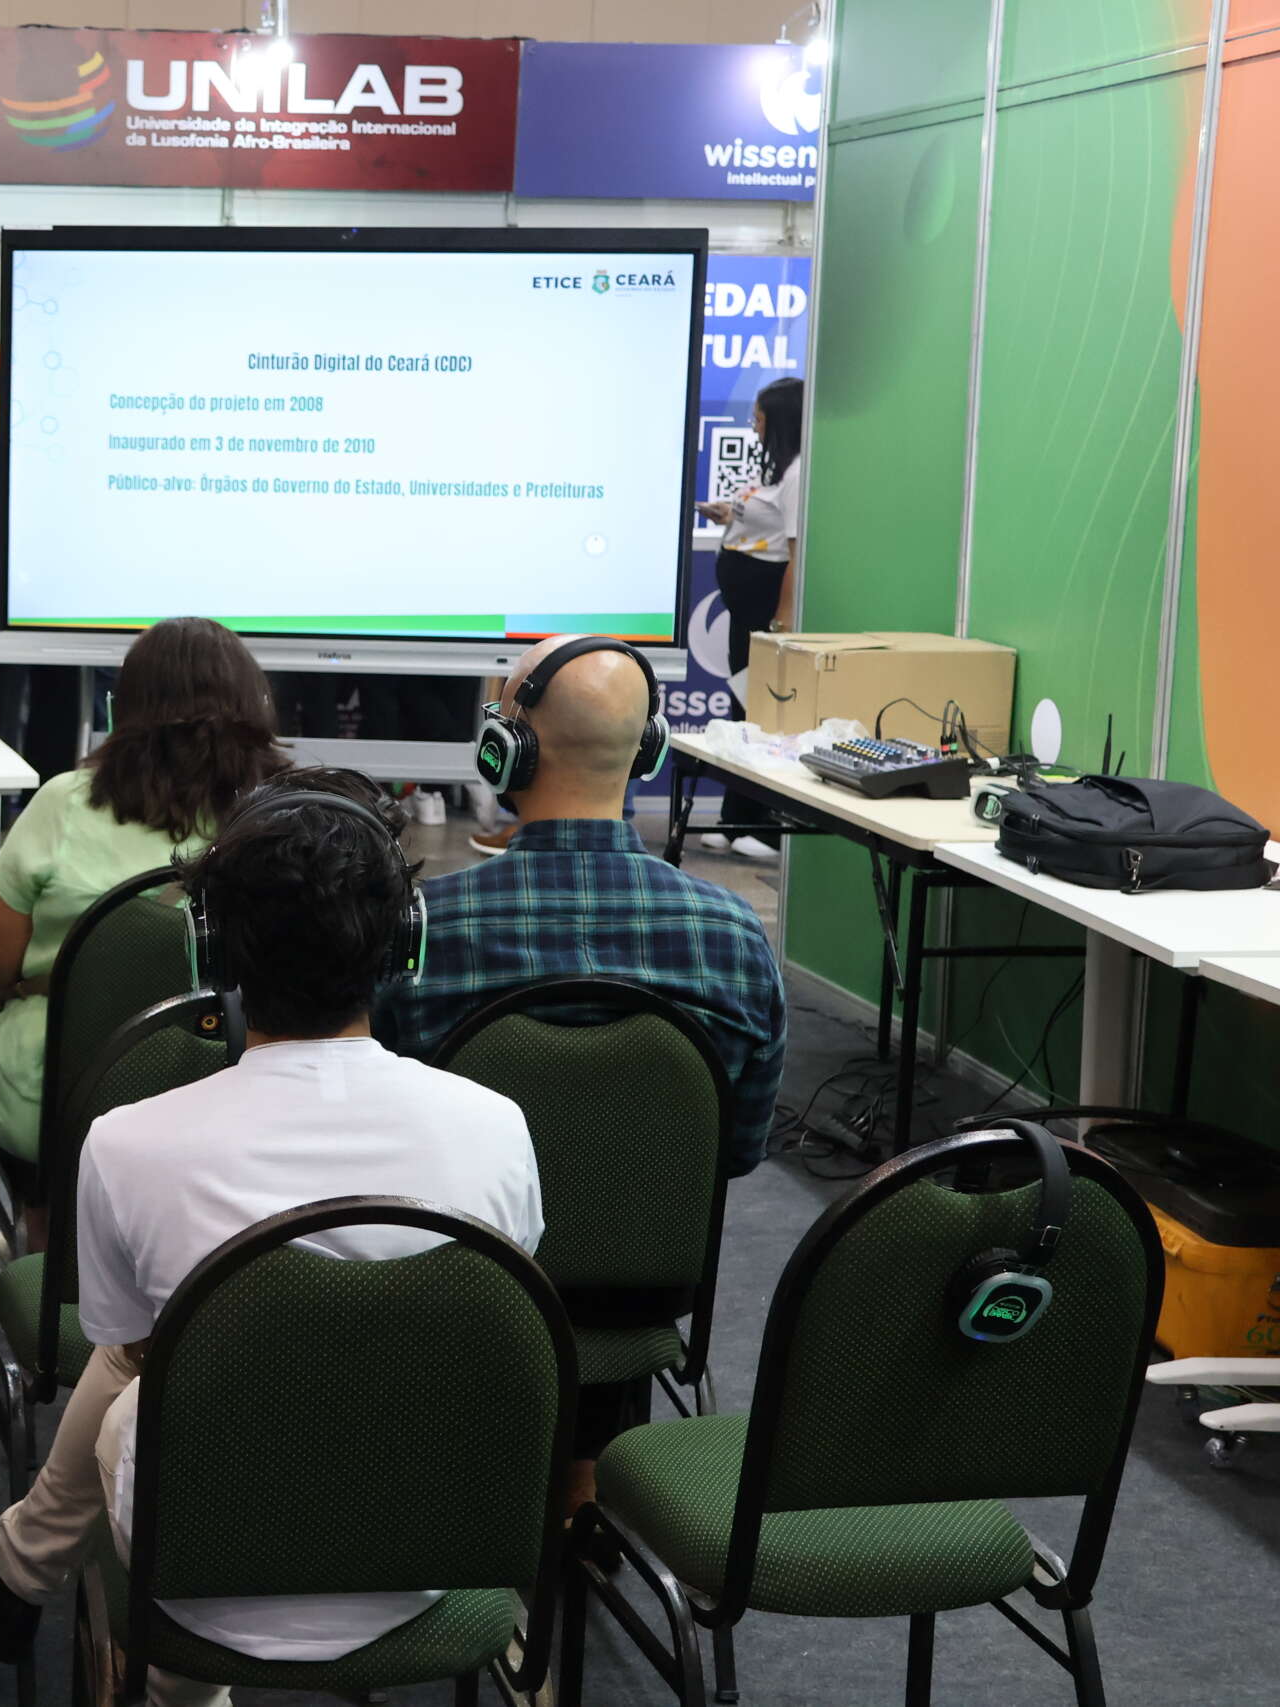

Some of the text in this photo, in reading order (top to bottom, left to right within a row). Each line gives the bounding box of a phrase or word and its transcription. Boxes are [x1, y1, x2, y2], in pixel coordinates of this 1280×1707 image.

[126, 60, 464, 116] UNILAB
[125, 115, 458, 136] Universidade da Integração Internacional
[125, 133, 352, 151] da Lusofonia Afro-Brasileira
[532, 271, 676, 289] ETICE CEARÁ
[247, 351, 473, 373] Cinturão Digital do Ceará (CDC)
[109, 393, 324, 415] Concepção do projeto em 2008
[108, 434, 376, 454] Inaugurado em 3 de novembro de 2010
[199, 473, 248, 494] Órgãos
[251, 477, 269, 494] do
[272, 477, 330, 495] Governo
[333, 479, 351, 495] do
[354, 479, 406, 497] Estado,
[409, 479, 509, 498] Universidades
[512, 483, 522, 497] e
[525, 481, 605, 500] Prefeituras
